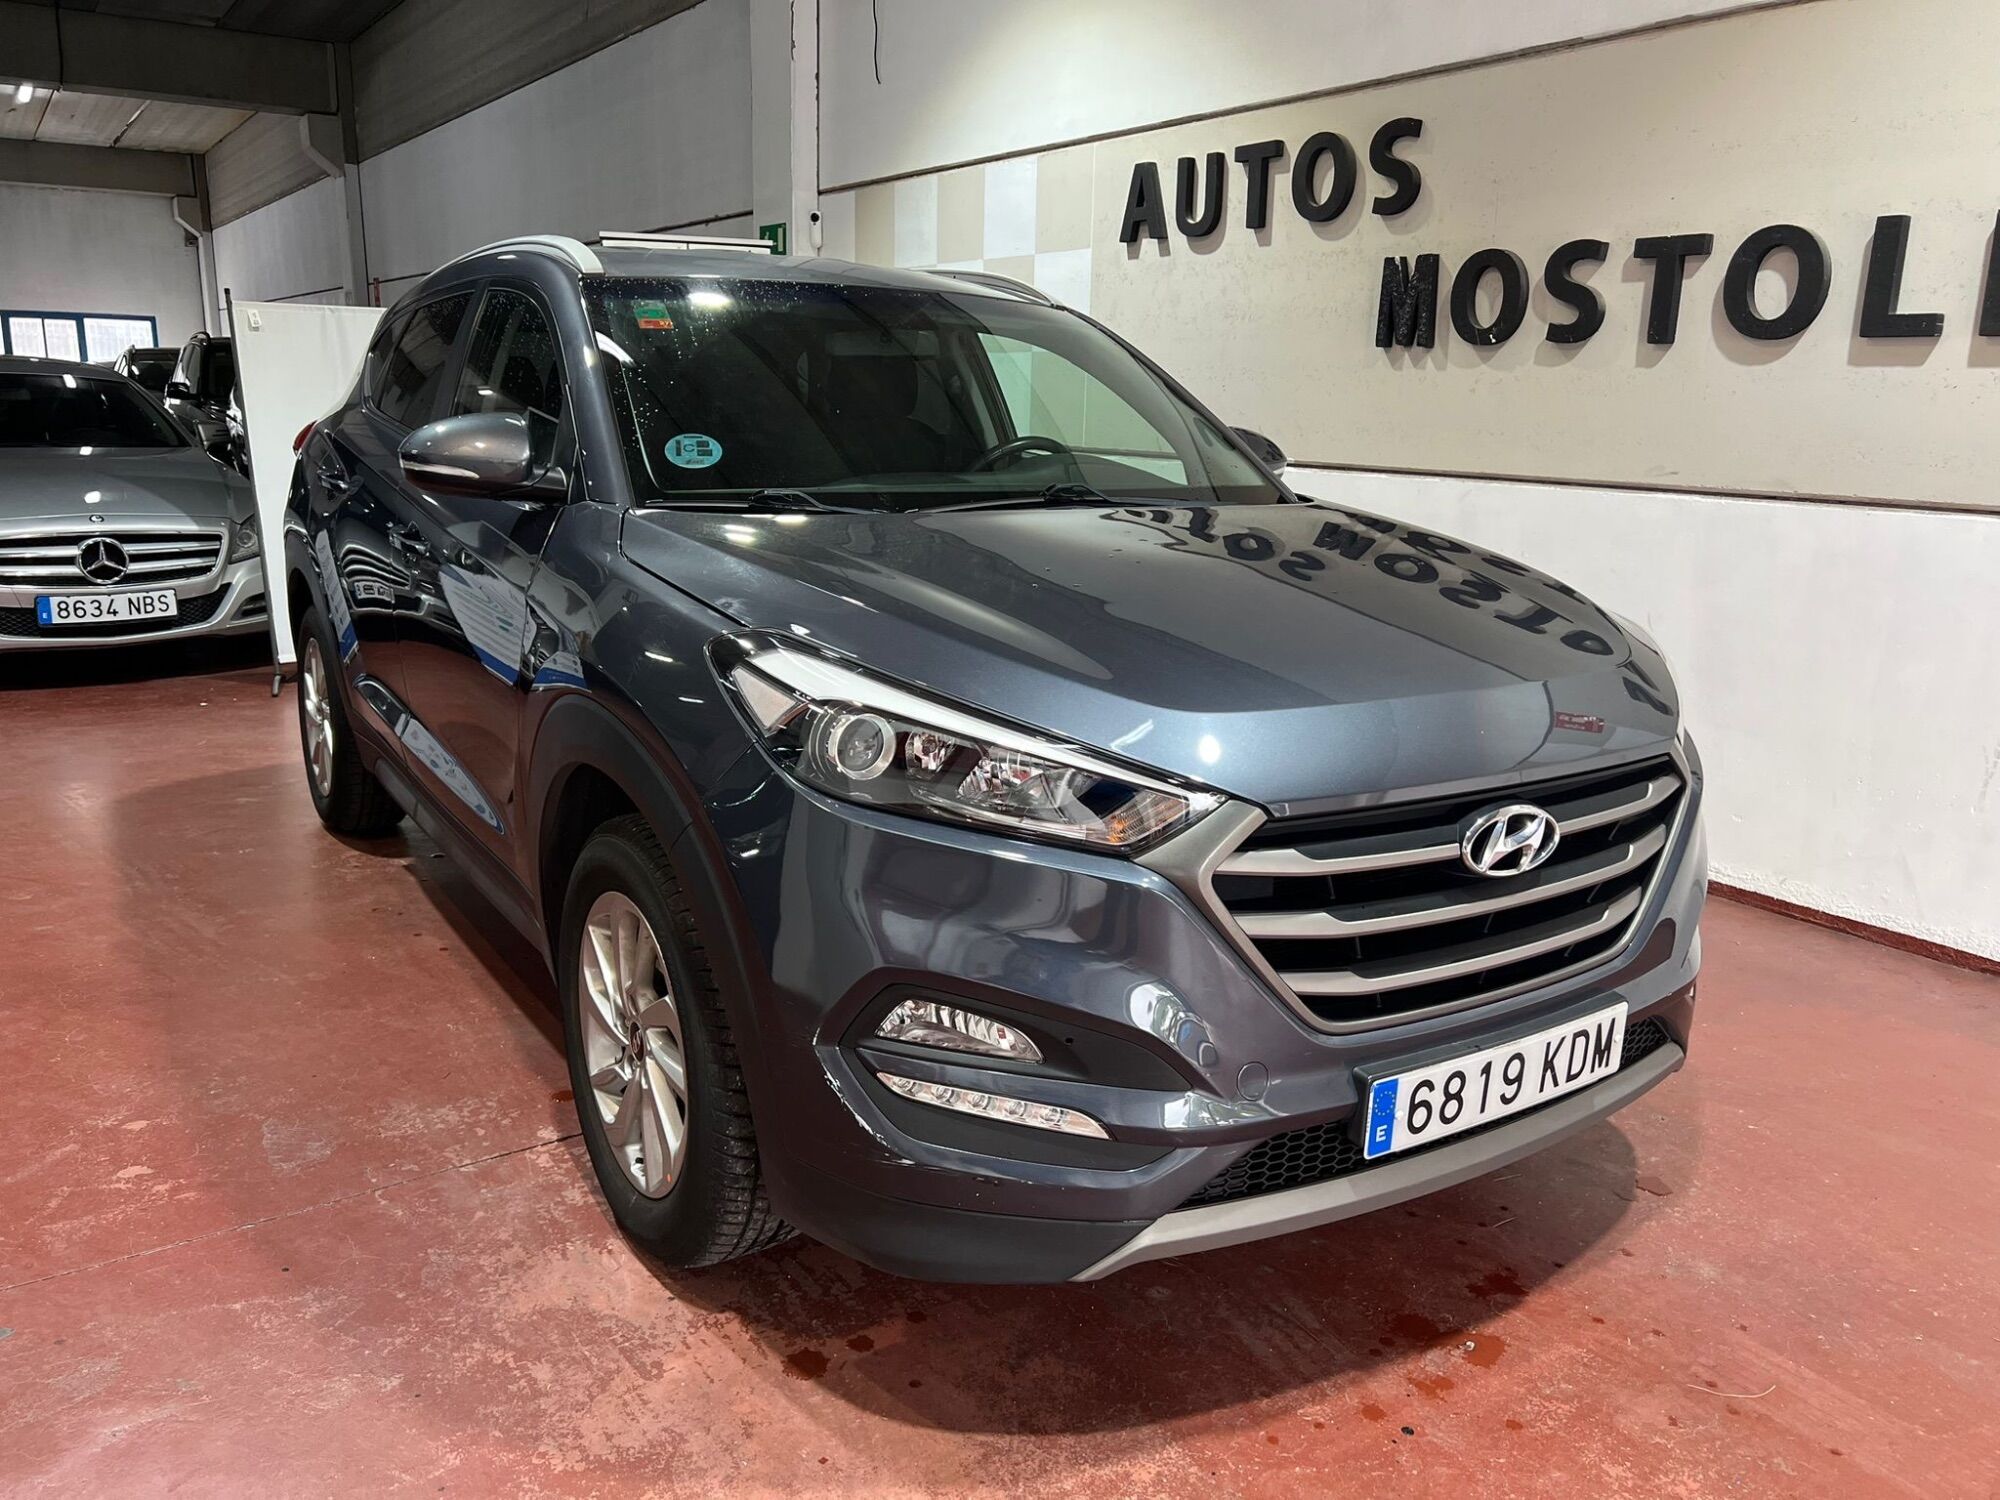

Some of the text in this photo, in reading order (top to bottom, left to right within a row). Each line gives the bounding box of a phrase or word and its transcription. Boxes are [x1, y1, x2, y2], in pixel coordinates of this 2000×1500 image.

[1119, 117, 1423, 243] AUTOS
[1375, 209, 2000, 348] MOSTOL
[57, 594, 170, 619] 8634 NBS
[1376, 1125, 1387, 1143] E
[1407, 1017, 1616, 1135] 6819 KDM
